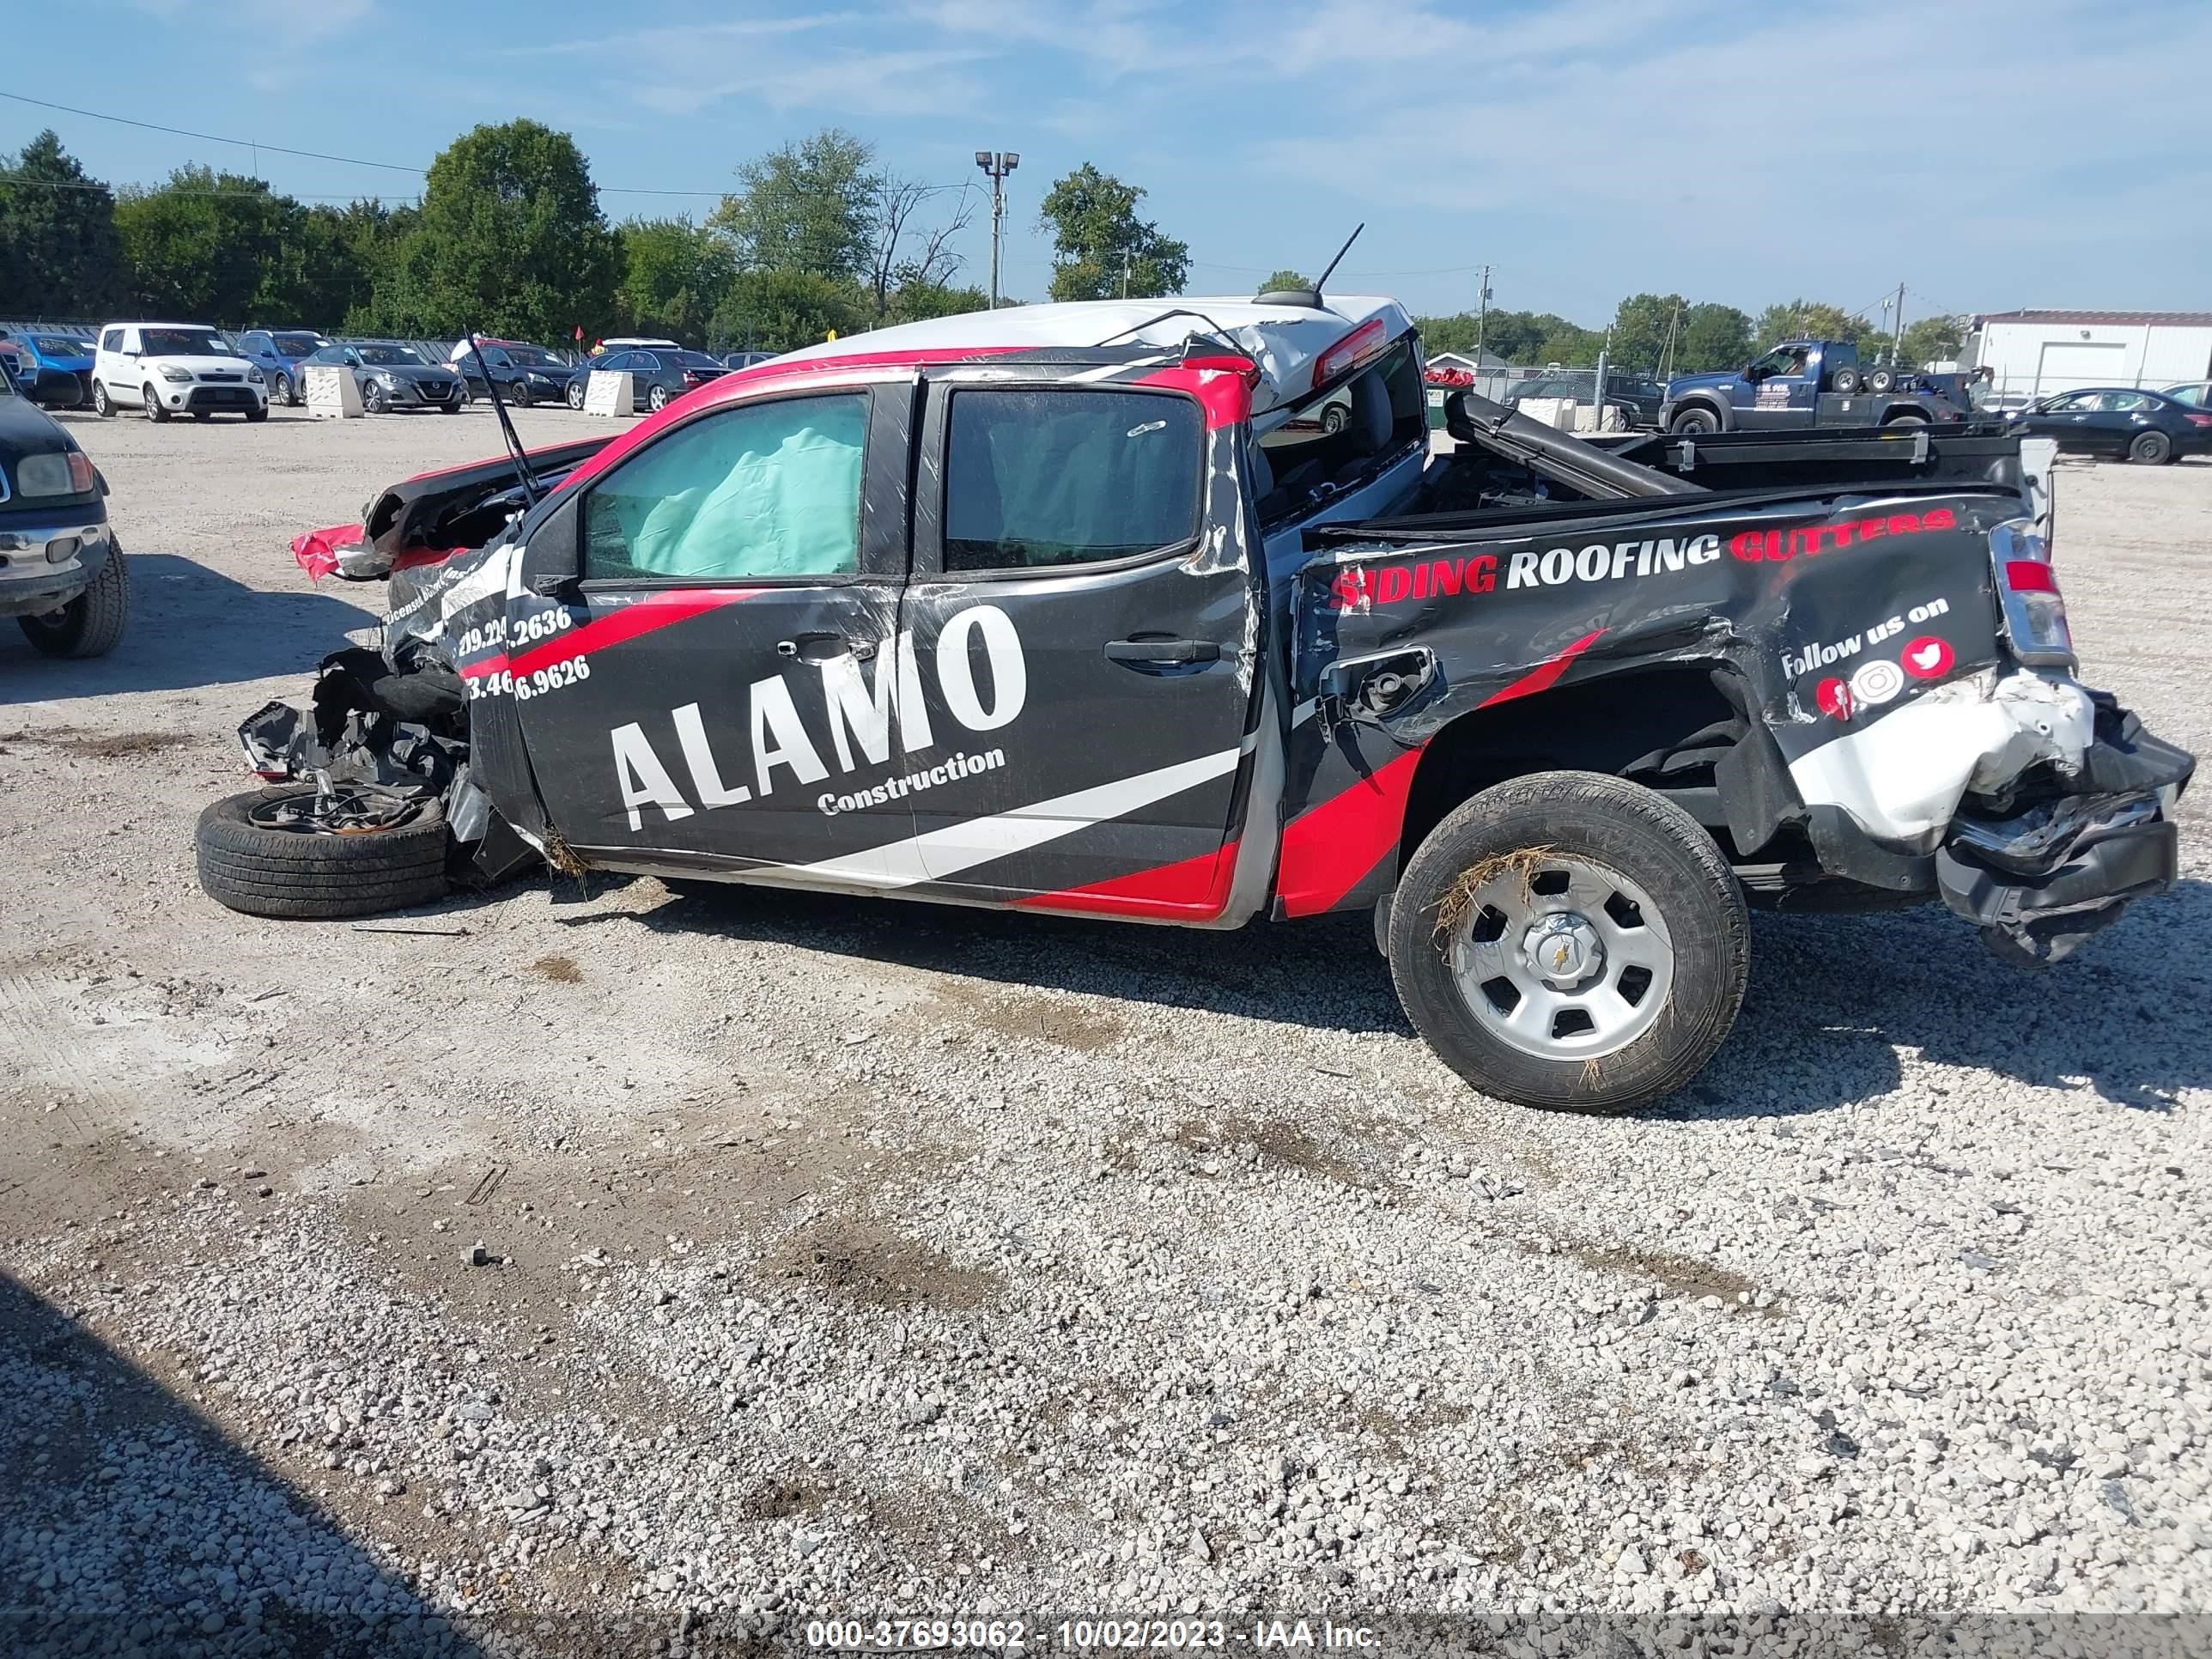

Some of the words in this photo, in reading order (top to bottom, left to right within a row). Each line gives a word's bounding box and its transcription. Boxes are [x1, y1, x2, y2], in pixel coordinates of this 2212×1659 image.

[1330, 555, 1498, 609] SIDING
[1506, 534, 1721, 590] ROOFING
[1730, 508, 1956, 562] GUTTERS
[1782, 634, 1862, 679] Follow
[1867, 616, 1905, 645] us
[1908, 598, 1949, 623] on
[611, 605, 1027, 831] ALAMO
[817, 748, 1006, 816] Construction
